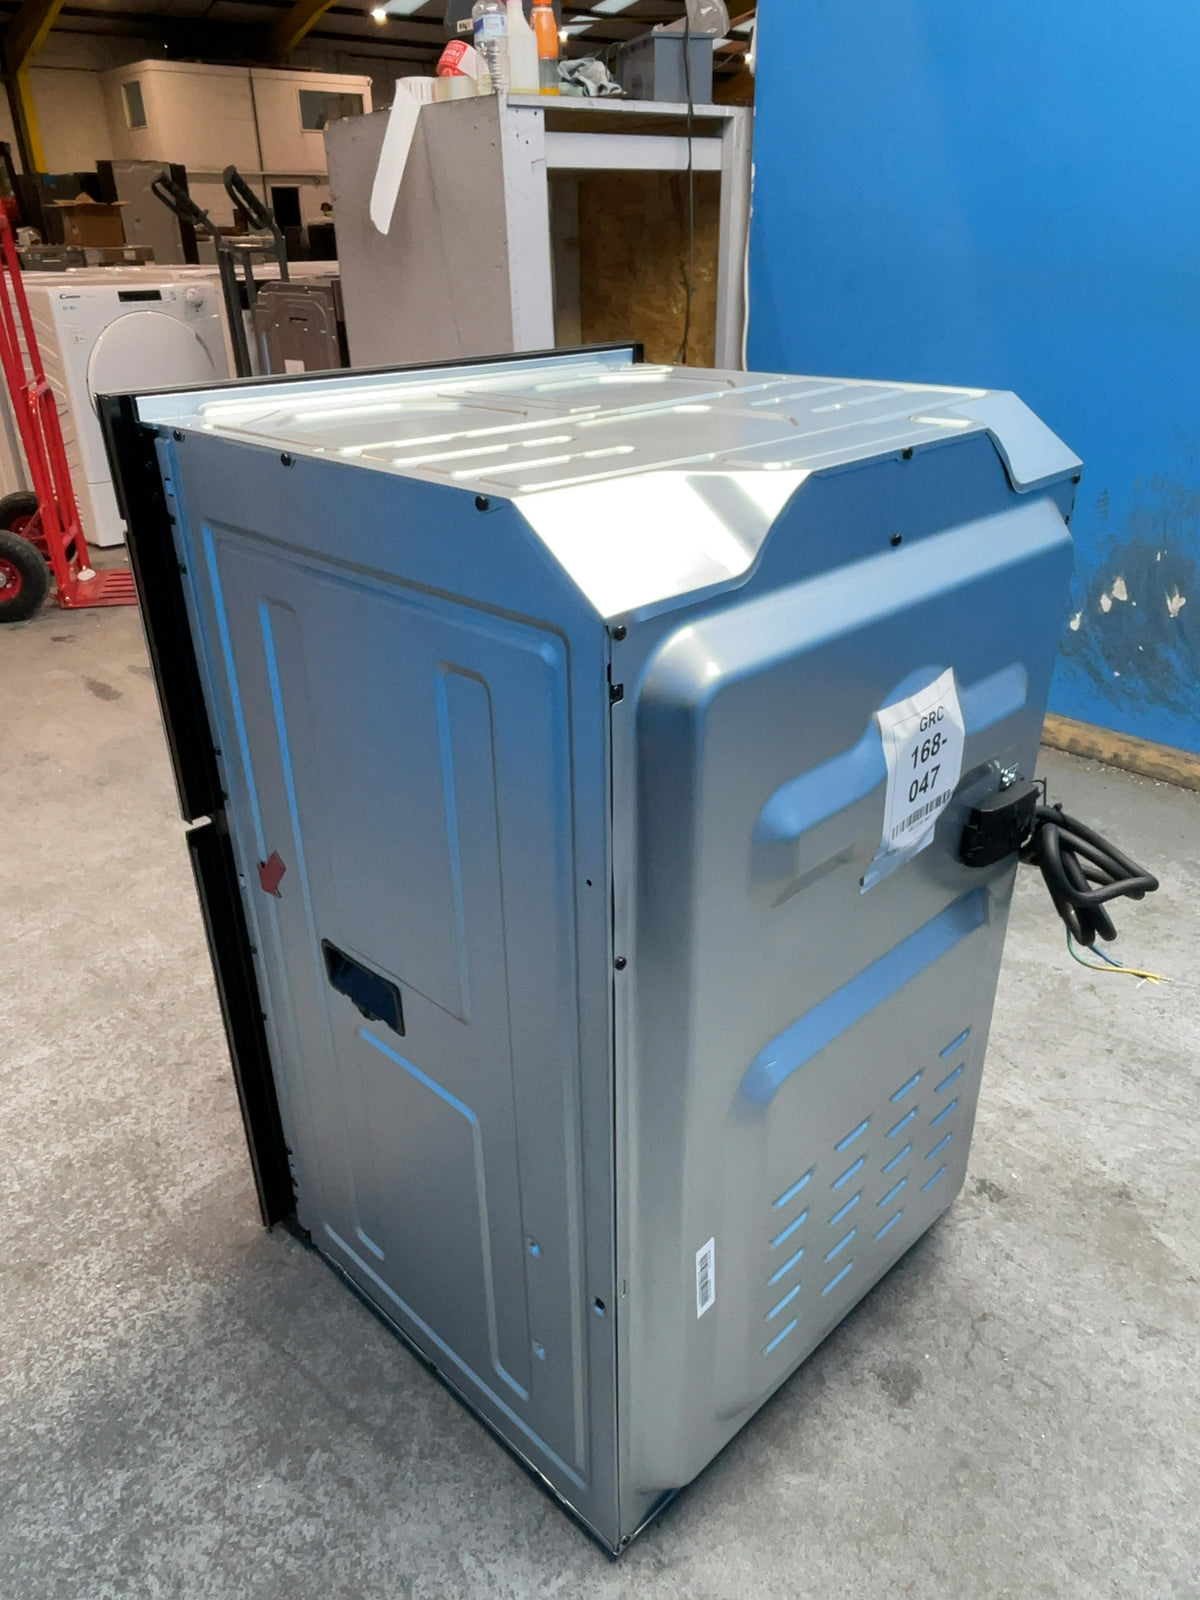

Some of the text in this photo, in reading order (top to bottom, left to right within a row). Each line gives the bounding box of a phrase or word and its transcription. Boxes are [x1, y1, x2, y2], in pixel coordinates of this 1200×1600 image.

[919, 706, 944, 732] GRC
[911, 733, 948, 769] 168-
[909, 765, 941, 802] 047
